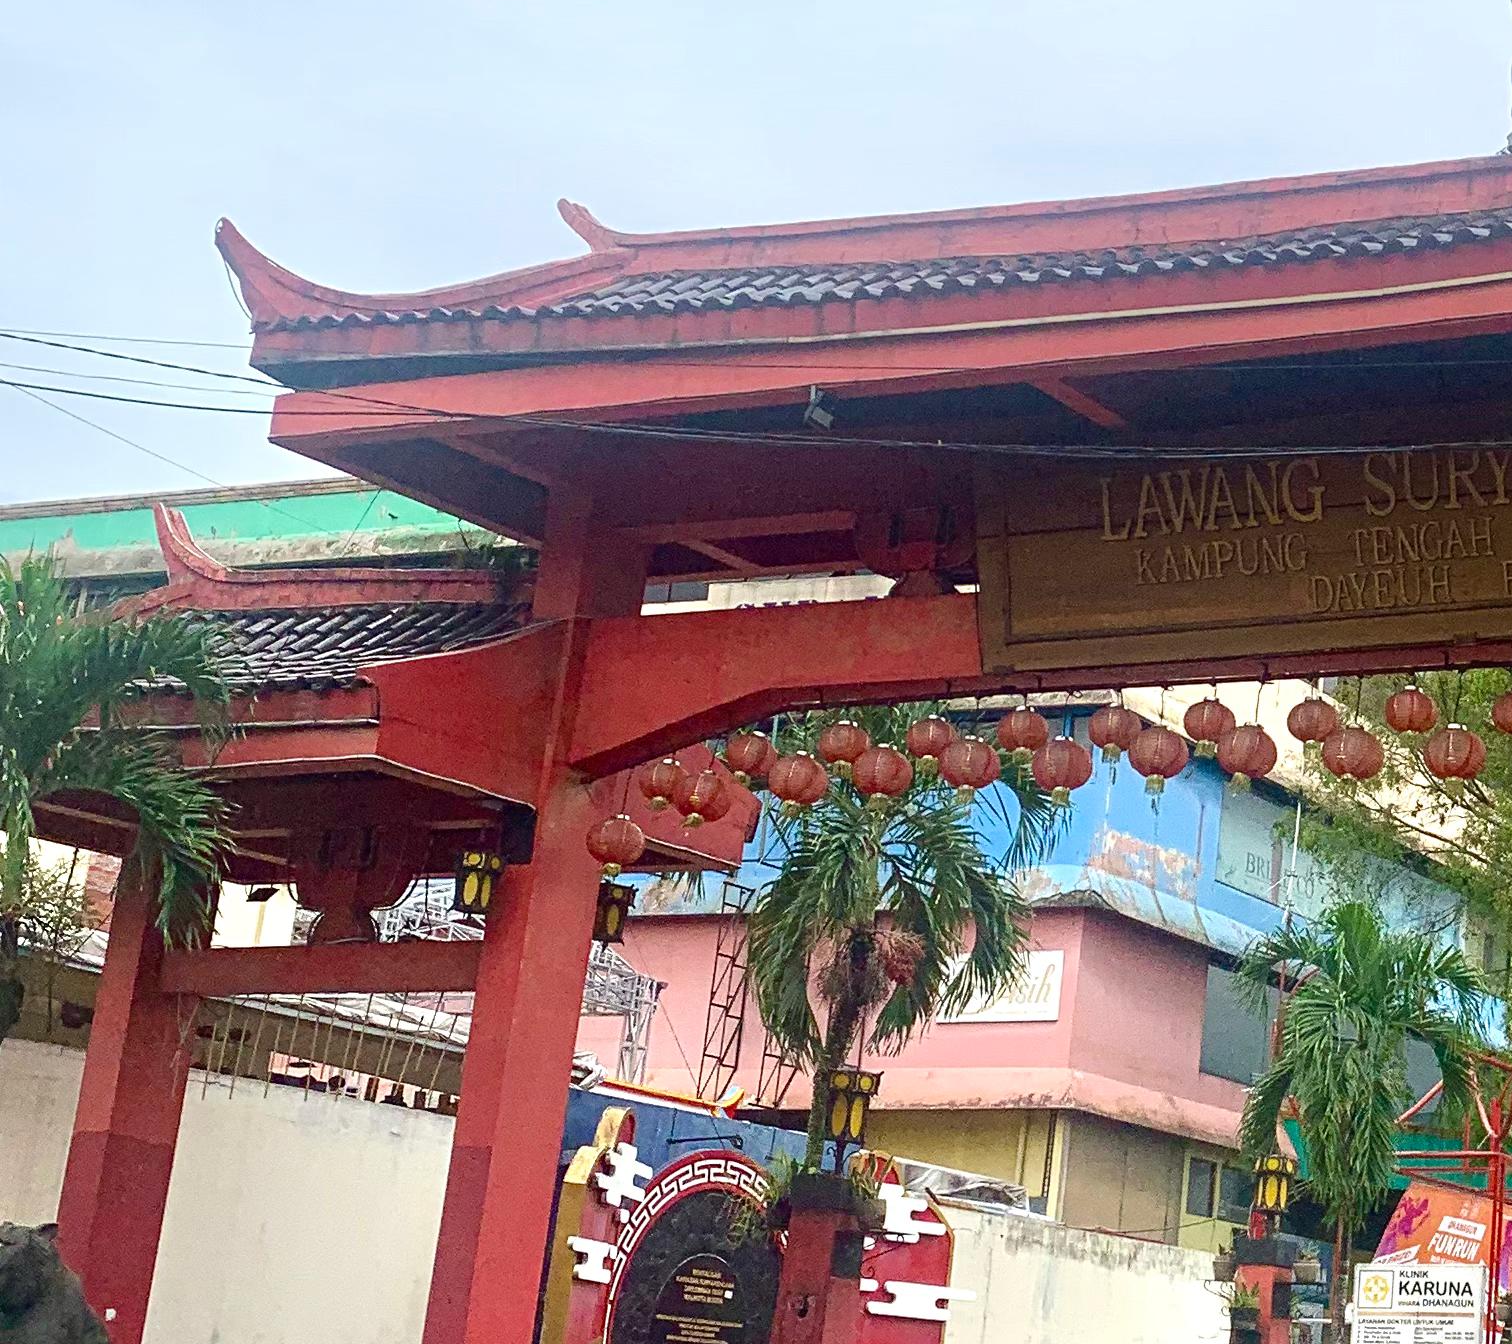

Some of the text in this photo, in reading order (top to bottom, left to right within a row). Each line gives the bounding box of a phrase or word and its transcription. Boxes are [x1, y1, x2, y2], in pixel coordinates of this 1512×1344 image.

[1100, 458, 1326, 541] LAWANG
[1135, 533, 1308, 585] KAMPUNG
[1352, 515, 1495, 567] TENGAH
[1311, 564, 1454, 613] DAYEUH
[1398, 1281, 1473, 1296] KARUNA
[1399, 1270, 1429, 1278] KLINIK
[1422, 1298, 1474, 1308] DHANAGUN
